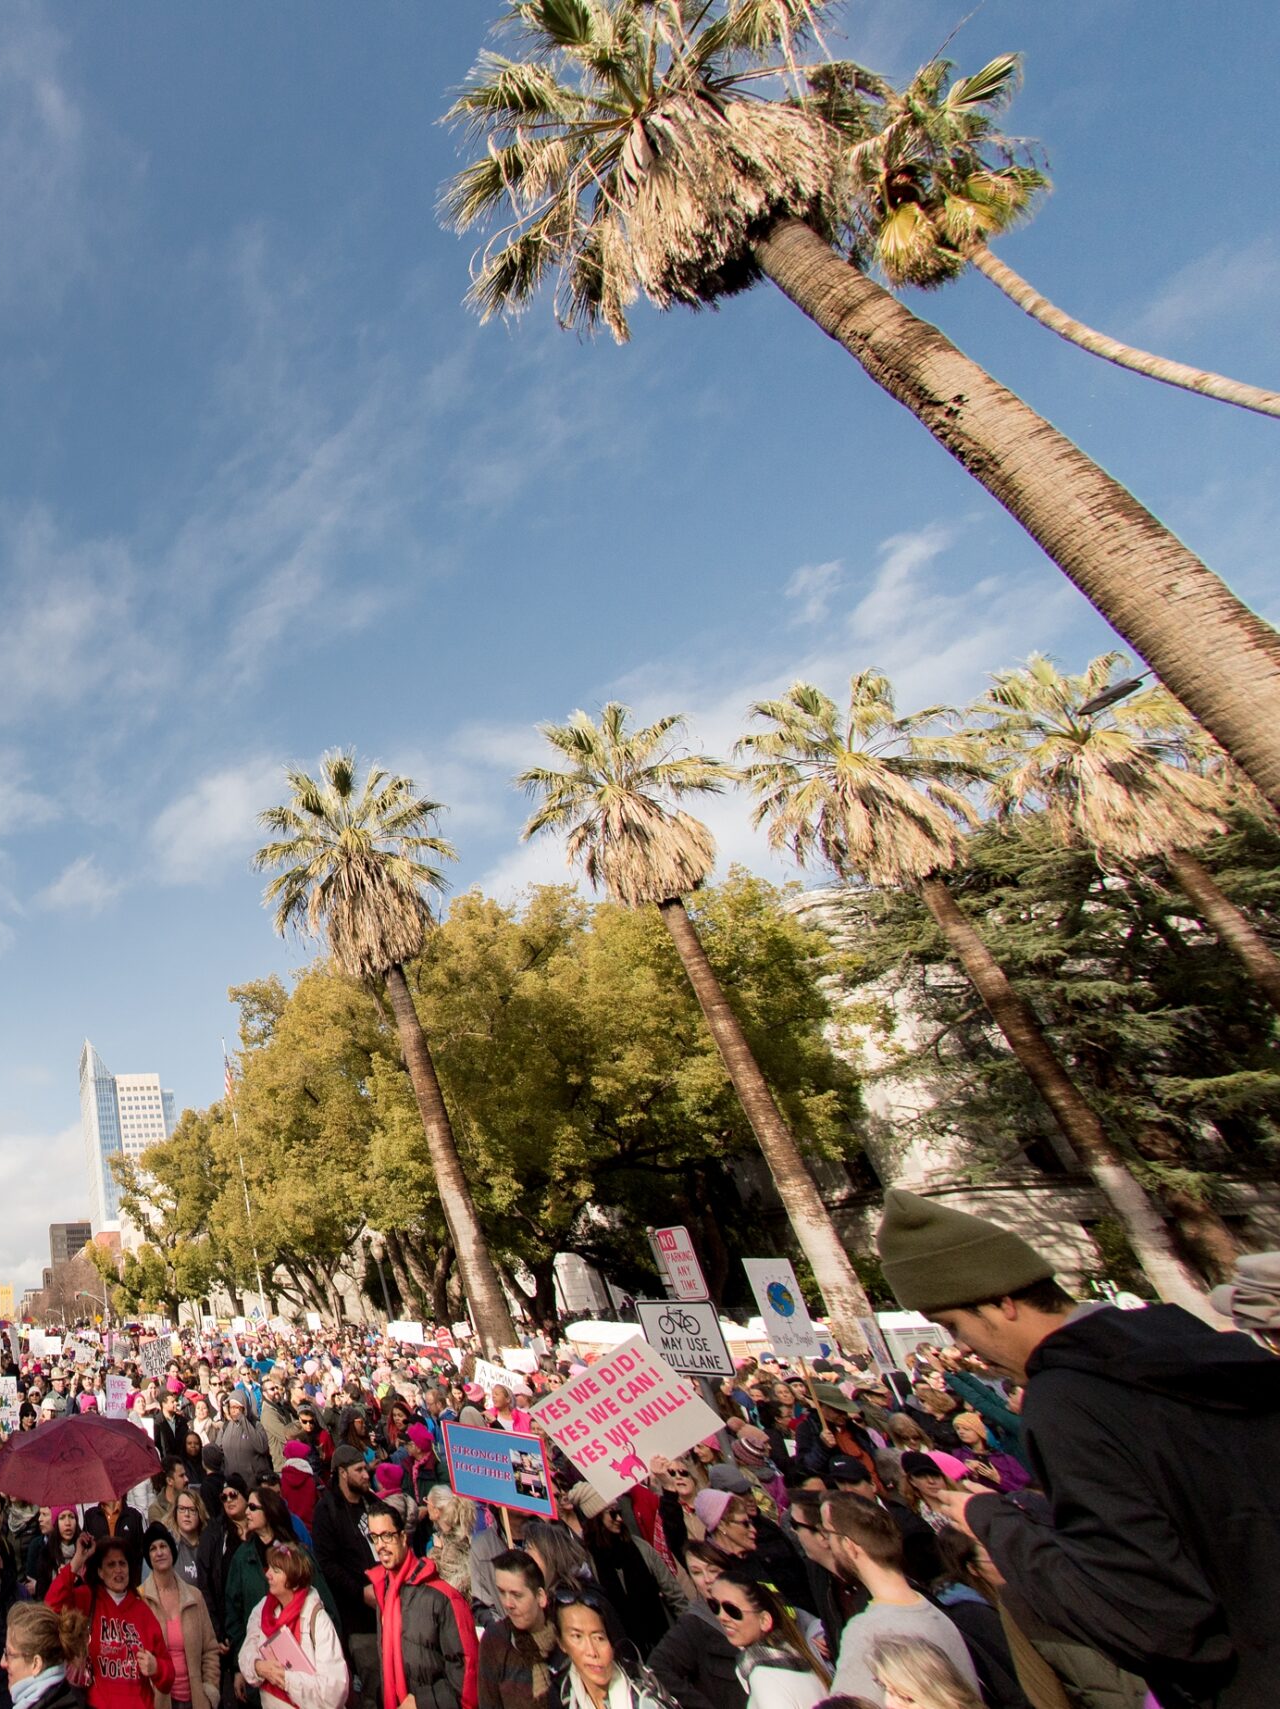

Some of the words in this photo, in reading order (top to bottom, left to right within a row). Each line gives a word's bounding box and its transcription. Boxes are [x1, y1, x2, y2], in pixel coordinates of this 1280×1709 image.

[660, 1234, 676, 1249] NO
[665, 1250, 694, 1265] PARKING
[677, 1265, 691, 1278] ANY
[680, 1279, 699, 1291] TIME
[660, 1336, 683, 1350] MAY
[686, 1337, 711, 1352] USE
[691, 1354, 724, 1370] LANE
[480, 1365, 487, 1377] A
[110, 1379, 126, 1389] HOPE
[535, 1398, 571, 1425] YES
[567, 1377, 601, 1405] WE
[552, 1418, 591, 1447] YES
[585, 1396, 622, 1425] WE
[571, 1438, 609, 1469] YES
[603, 1417, 641, 1448] WE
[451, 1444, 509, 1465] STRONGER
[455, 1460, 512, 1482] TOGETHER
